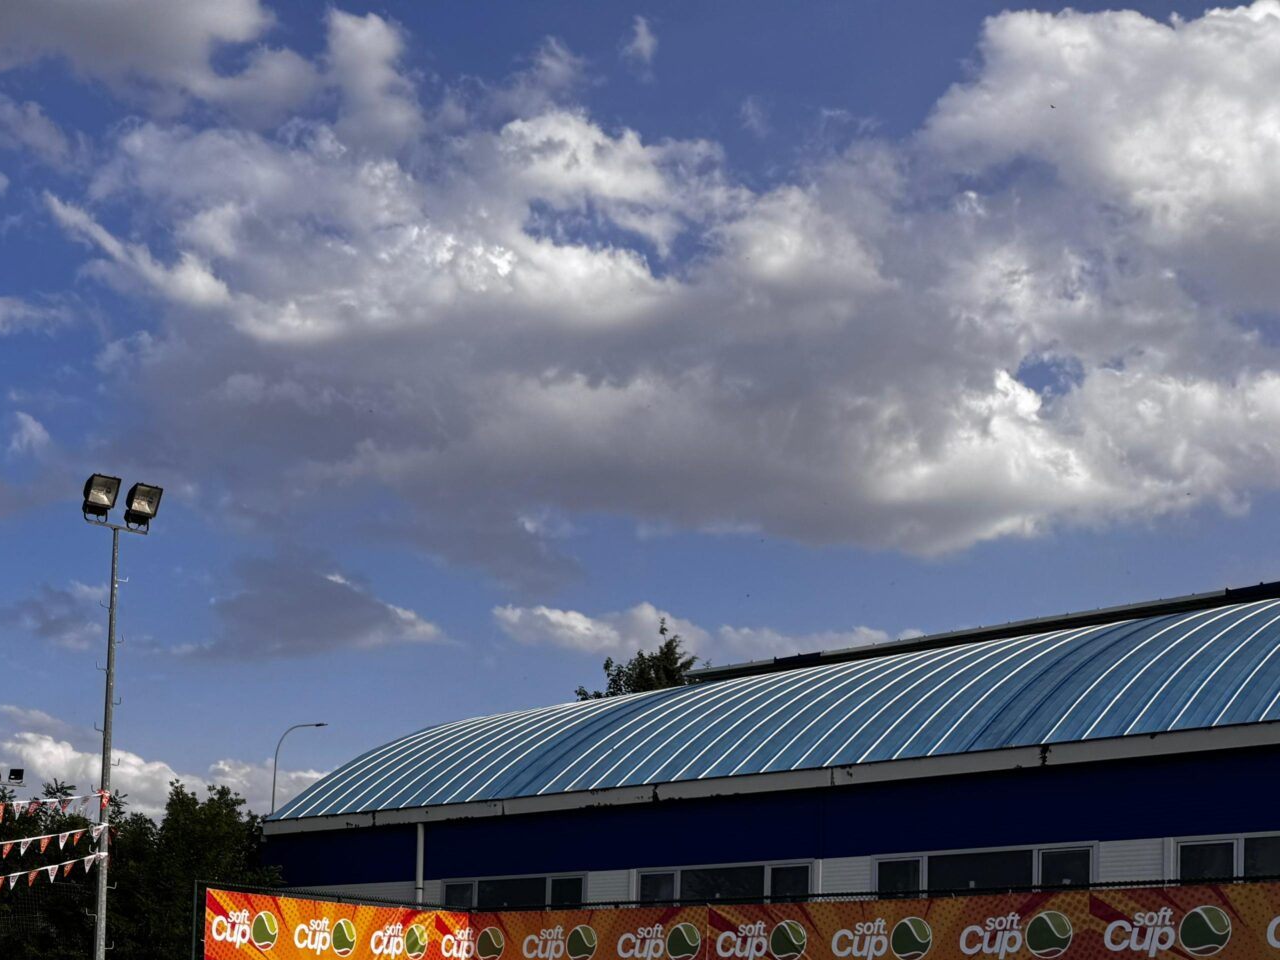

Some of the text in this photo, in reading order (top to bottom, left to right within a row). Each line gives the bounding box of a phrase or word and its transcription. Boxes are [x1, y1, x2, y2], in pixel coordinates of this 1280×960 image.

[212, 916, 251, 949] Cup
[294, 923, 331, 955] Cup
[371, 930, 404, 960] Cup
[959, 925, 1022, 960] Cup
[1103, 920, 1175, 958] Cup
